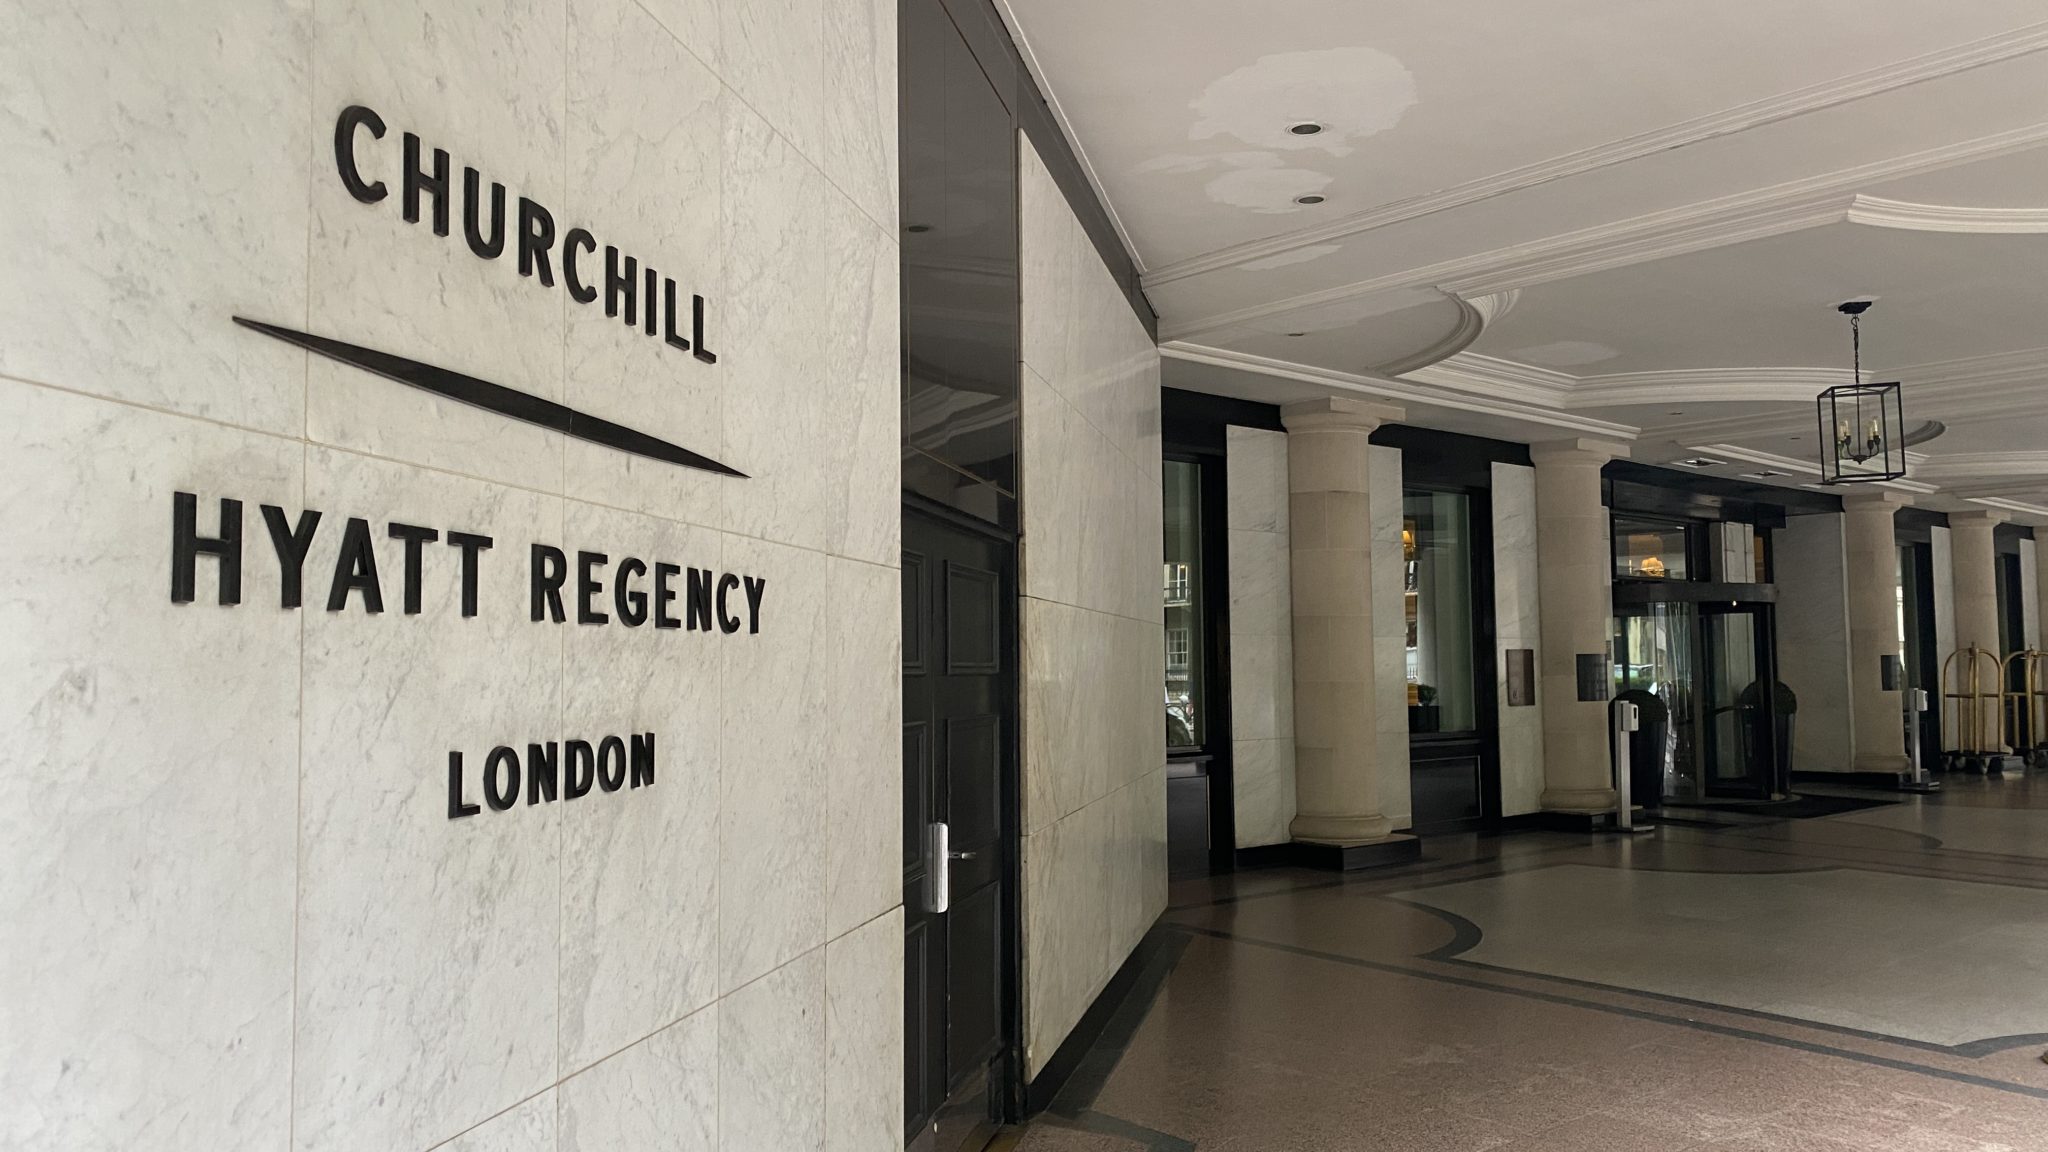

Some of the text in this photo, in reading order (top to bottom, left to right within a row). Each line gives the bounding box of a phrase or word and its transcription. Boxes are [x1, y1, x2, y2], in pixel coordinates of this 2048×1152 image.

[335, 105, 717, 364] CHURCHILL
[172, 491, 766, 635] HYATT REGENCY
[448, 733, 655, 820] LONDON
